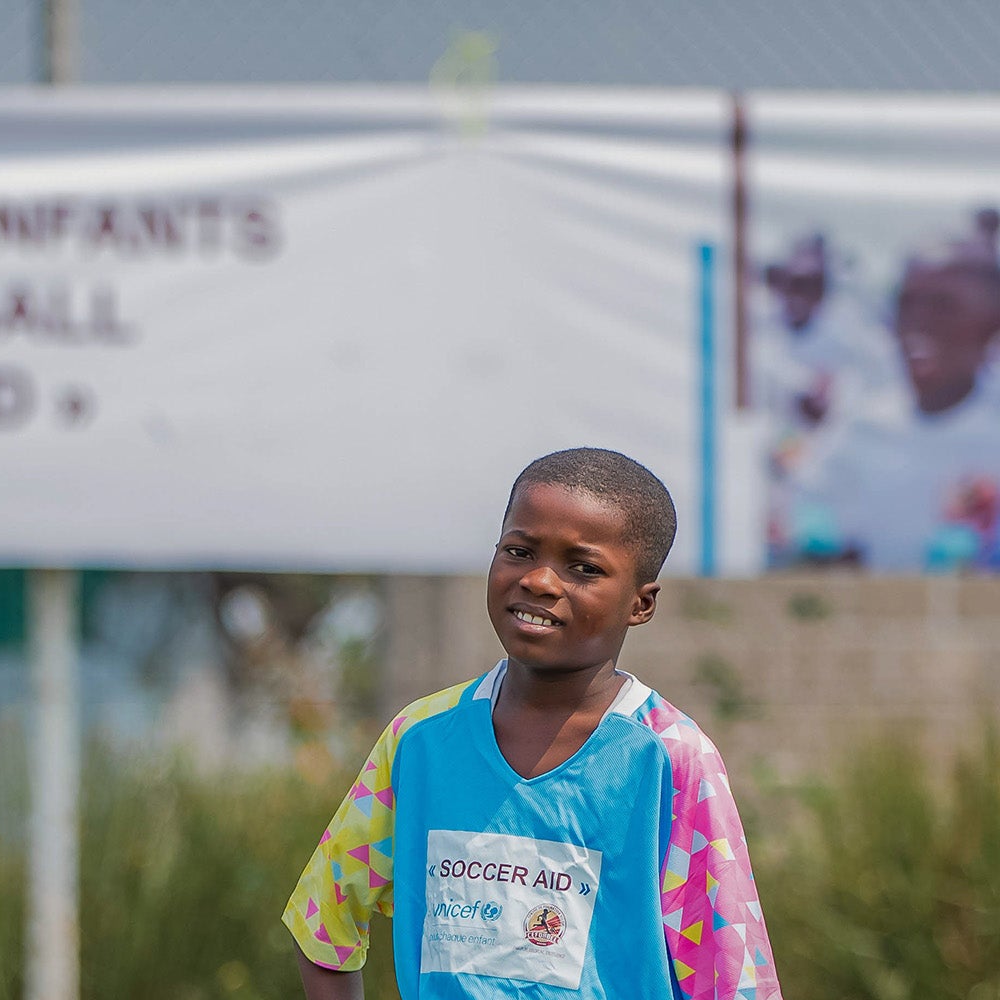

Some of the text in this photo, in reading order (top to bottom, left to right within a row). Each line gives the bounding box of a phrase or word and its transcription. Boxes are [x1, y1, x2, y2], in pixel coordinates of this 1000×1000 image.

[440, 859, 529, 886] SOCCER
[533, 870, 572, 891] AID
[468, 934, 497, 946] enfant
